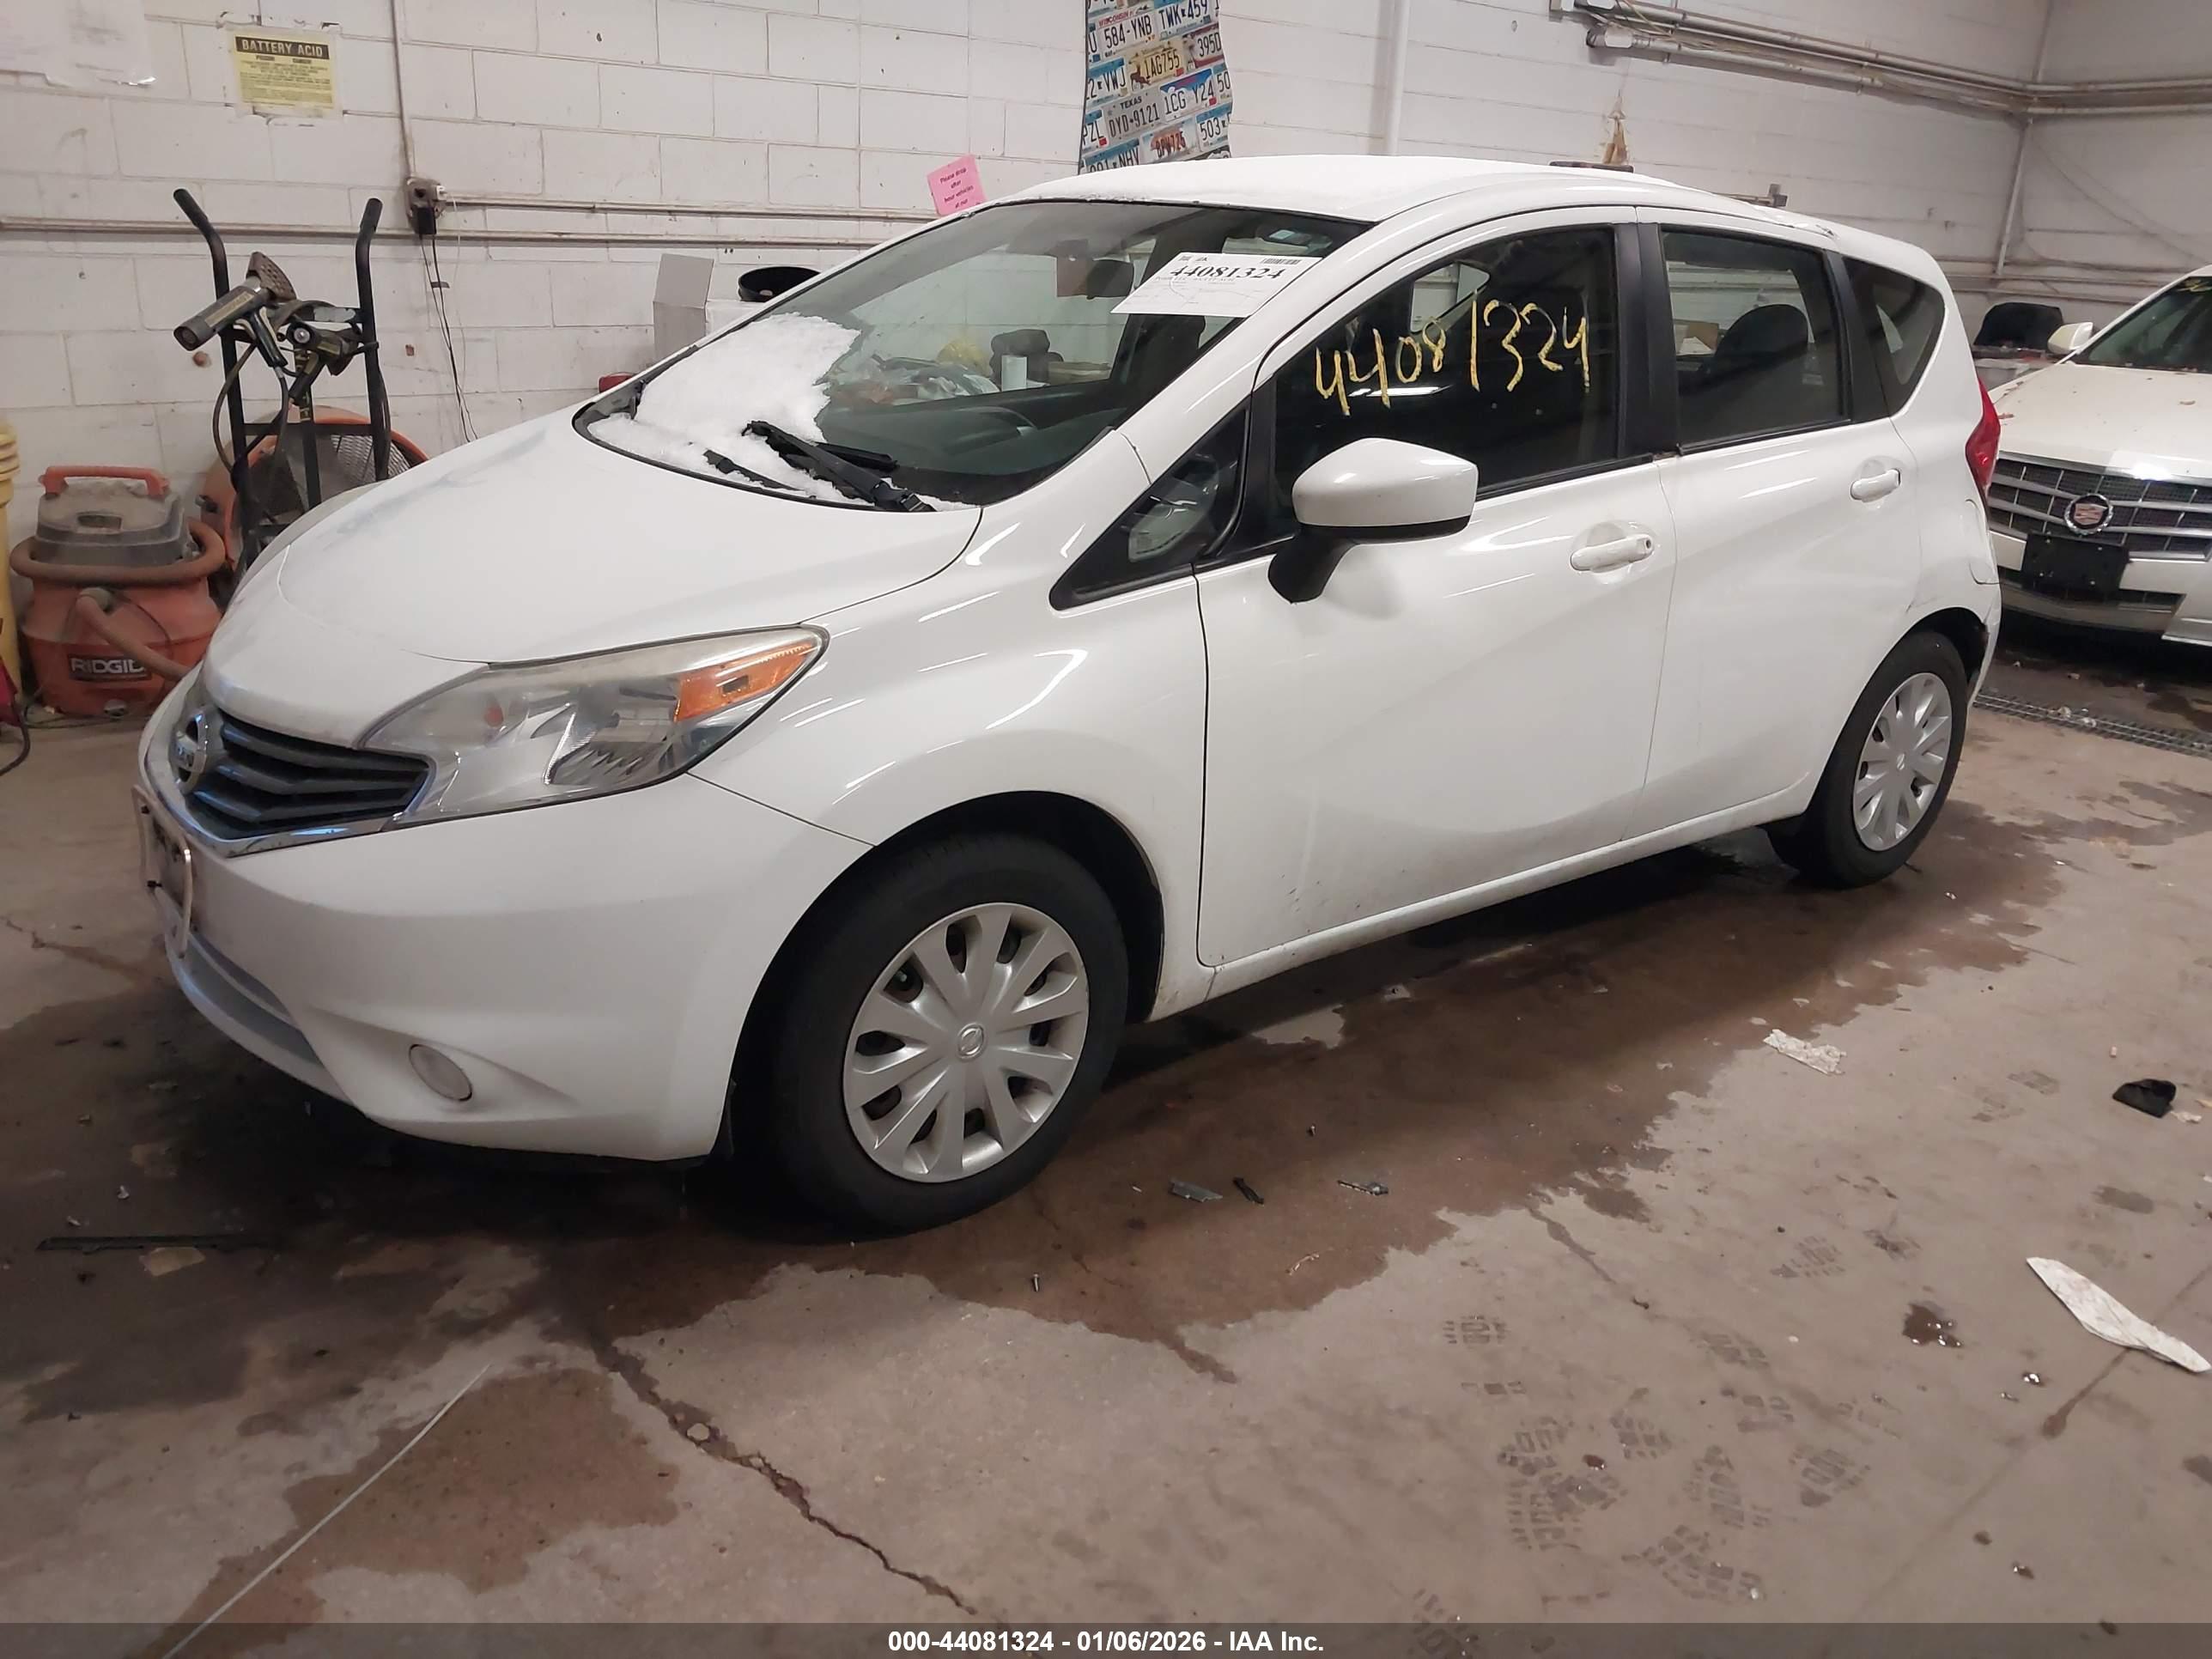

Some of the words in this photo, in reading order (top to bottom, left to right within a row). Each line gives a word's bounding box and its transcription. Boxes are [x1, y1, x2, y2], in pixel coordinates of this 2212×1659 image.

[1159, 6, 1182, 29] TWK
[1104, 15, 1152, 49] 584-YNB
[241, 39, 292, 54] BATTERY
[298, 45, 323, 58] ACID
[1120, 96, 1143, 110] TEXAS
[1198, 116, 1222, 141] 503
[1170, 265, 1286, 279] 44081324
[1316, 290, 1590, 416] 44081324
[70, 658, 145, 674] RIDGID
